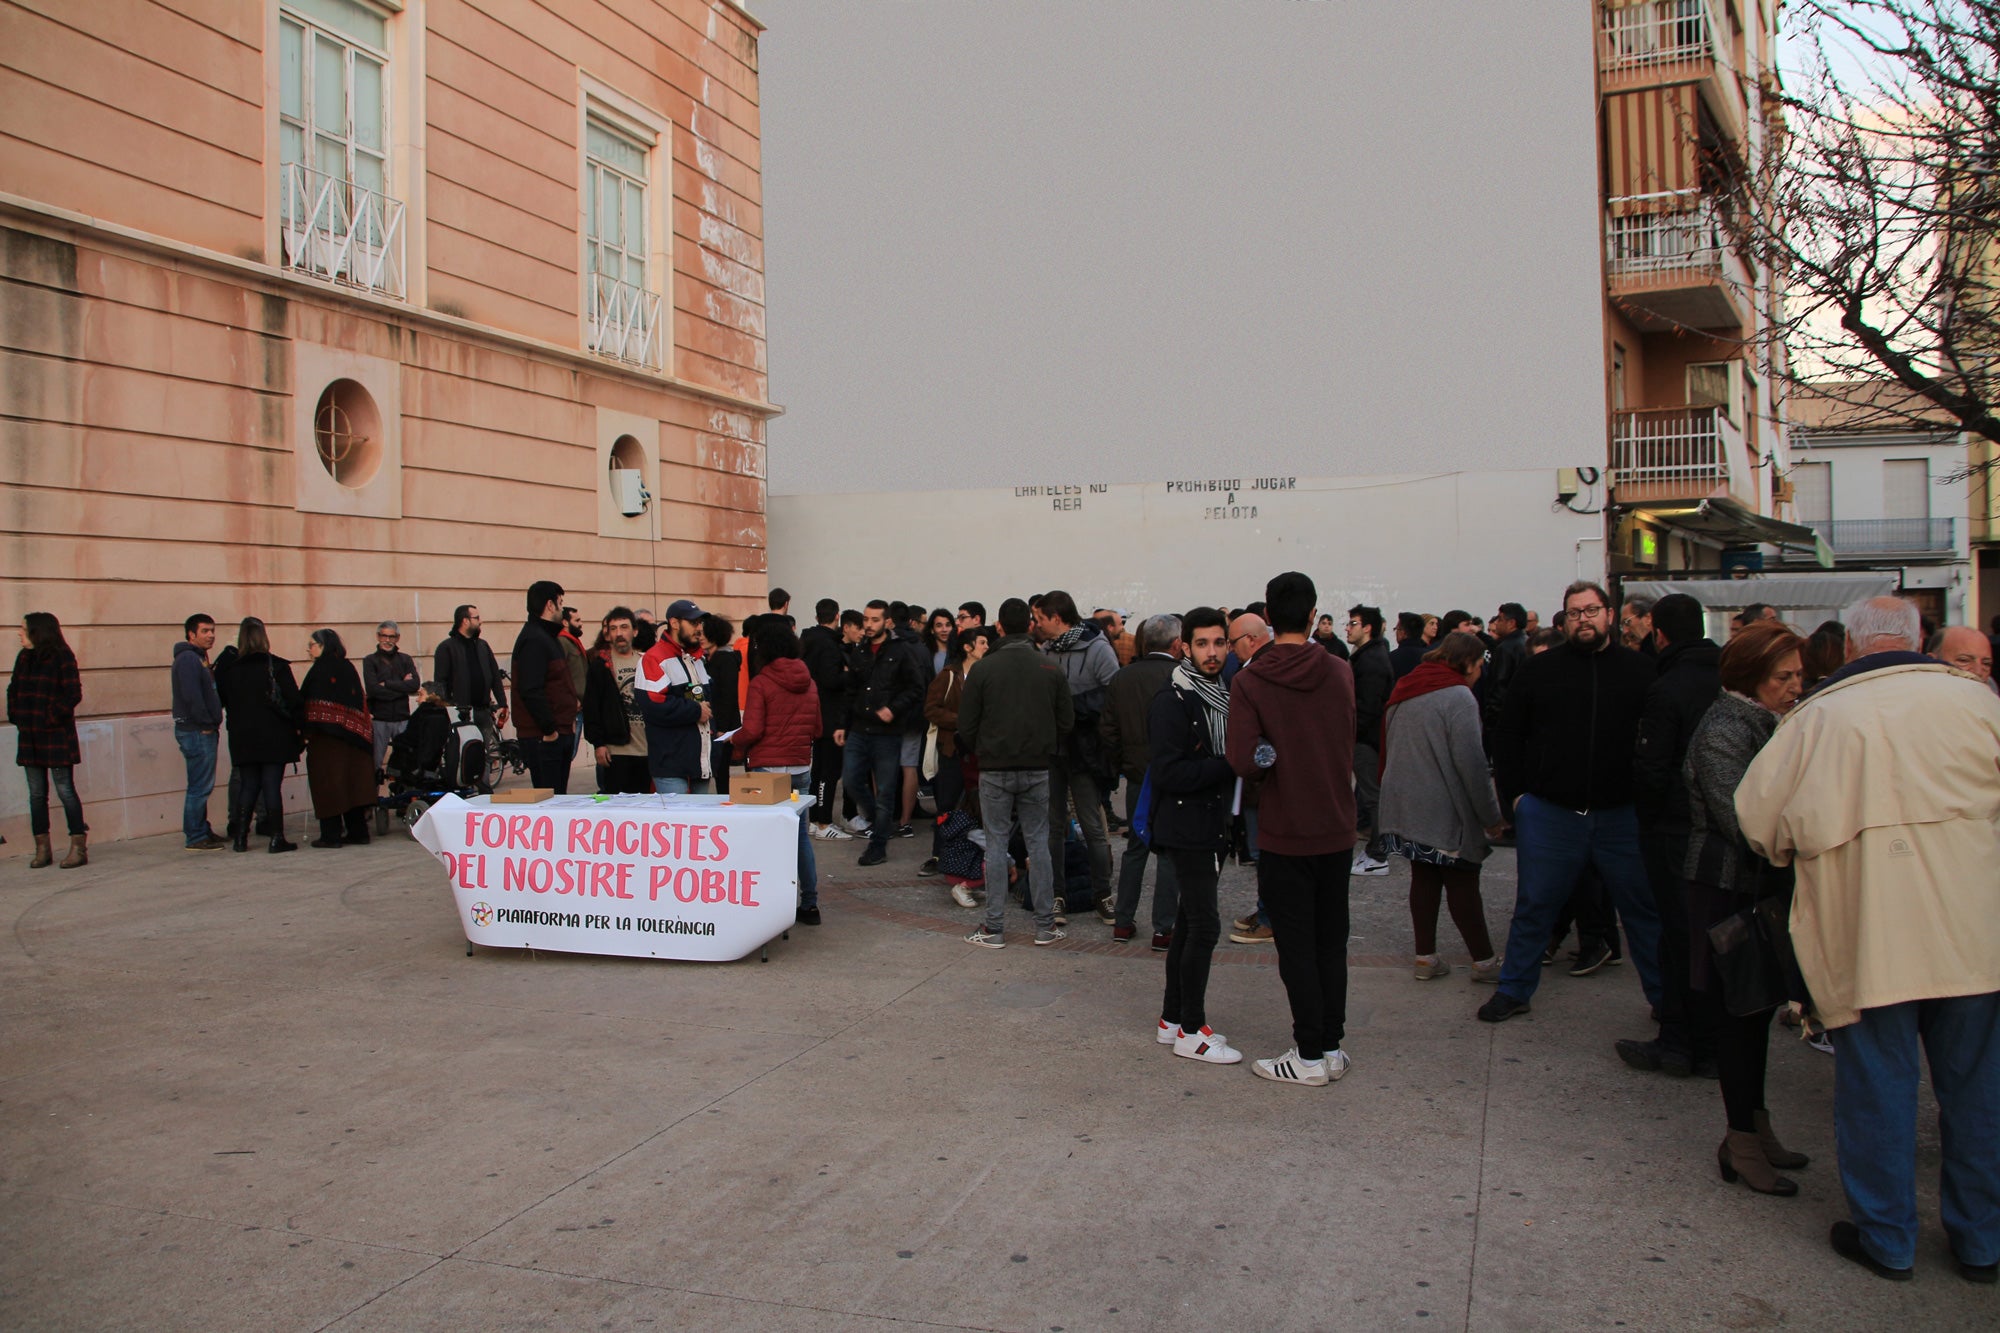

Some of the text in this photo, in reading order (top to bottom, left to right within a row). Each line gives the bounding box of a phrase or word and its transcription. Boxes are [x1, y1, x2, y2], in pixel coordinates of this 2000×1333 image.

[1251, 477, 1296, 490] JUGAR
[1227, 492, 1235, 505] A
[465, 812, 729, 861] FORA RACISTES
[504, 857, 635, 899] NOSTRE
[649, 866, 760, 906] POBLE
[497, 908, 715, 936] PLATAFORMA PER LA TOLERÀNCIA
